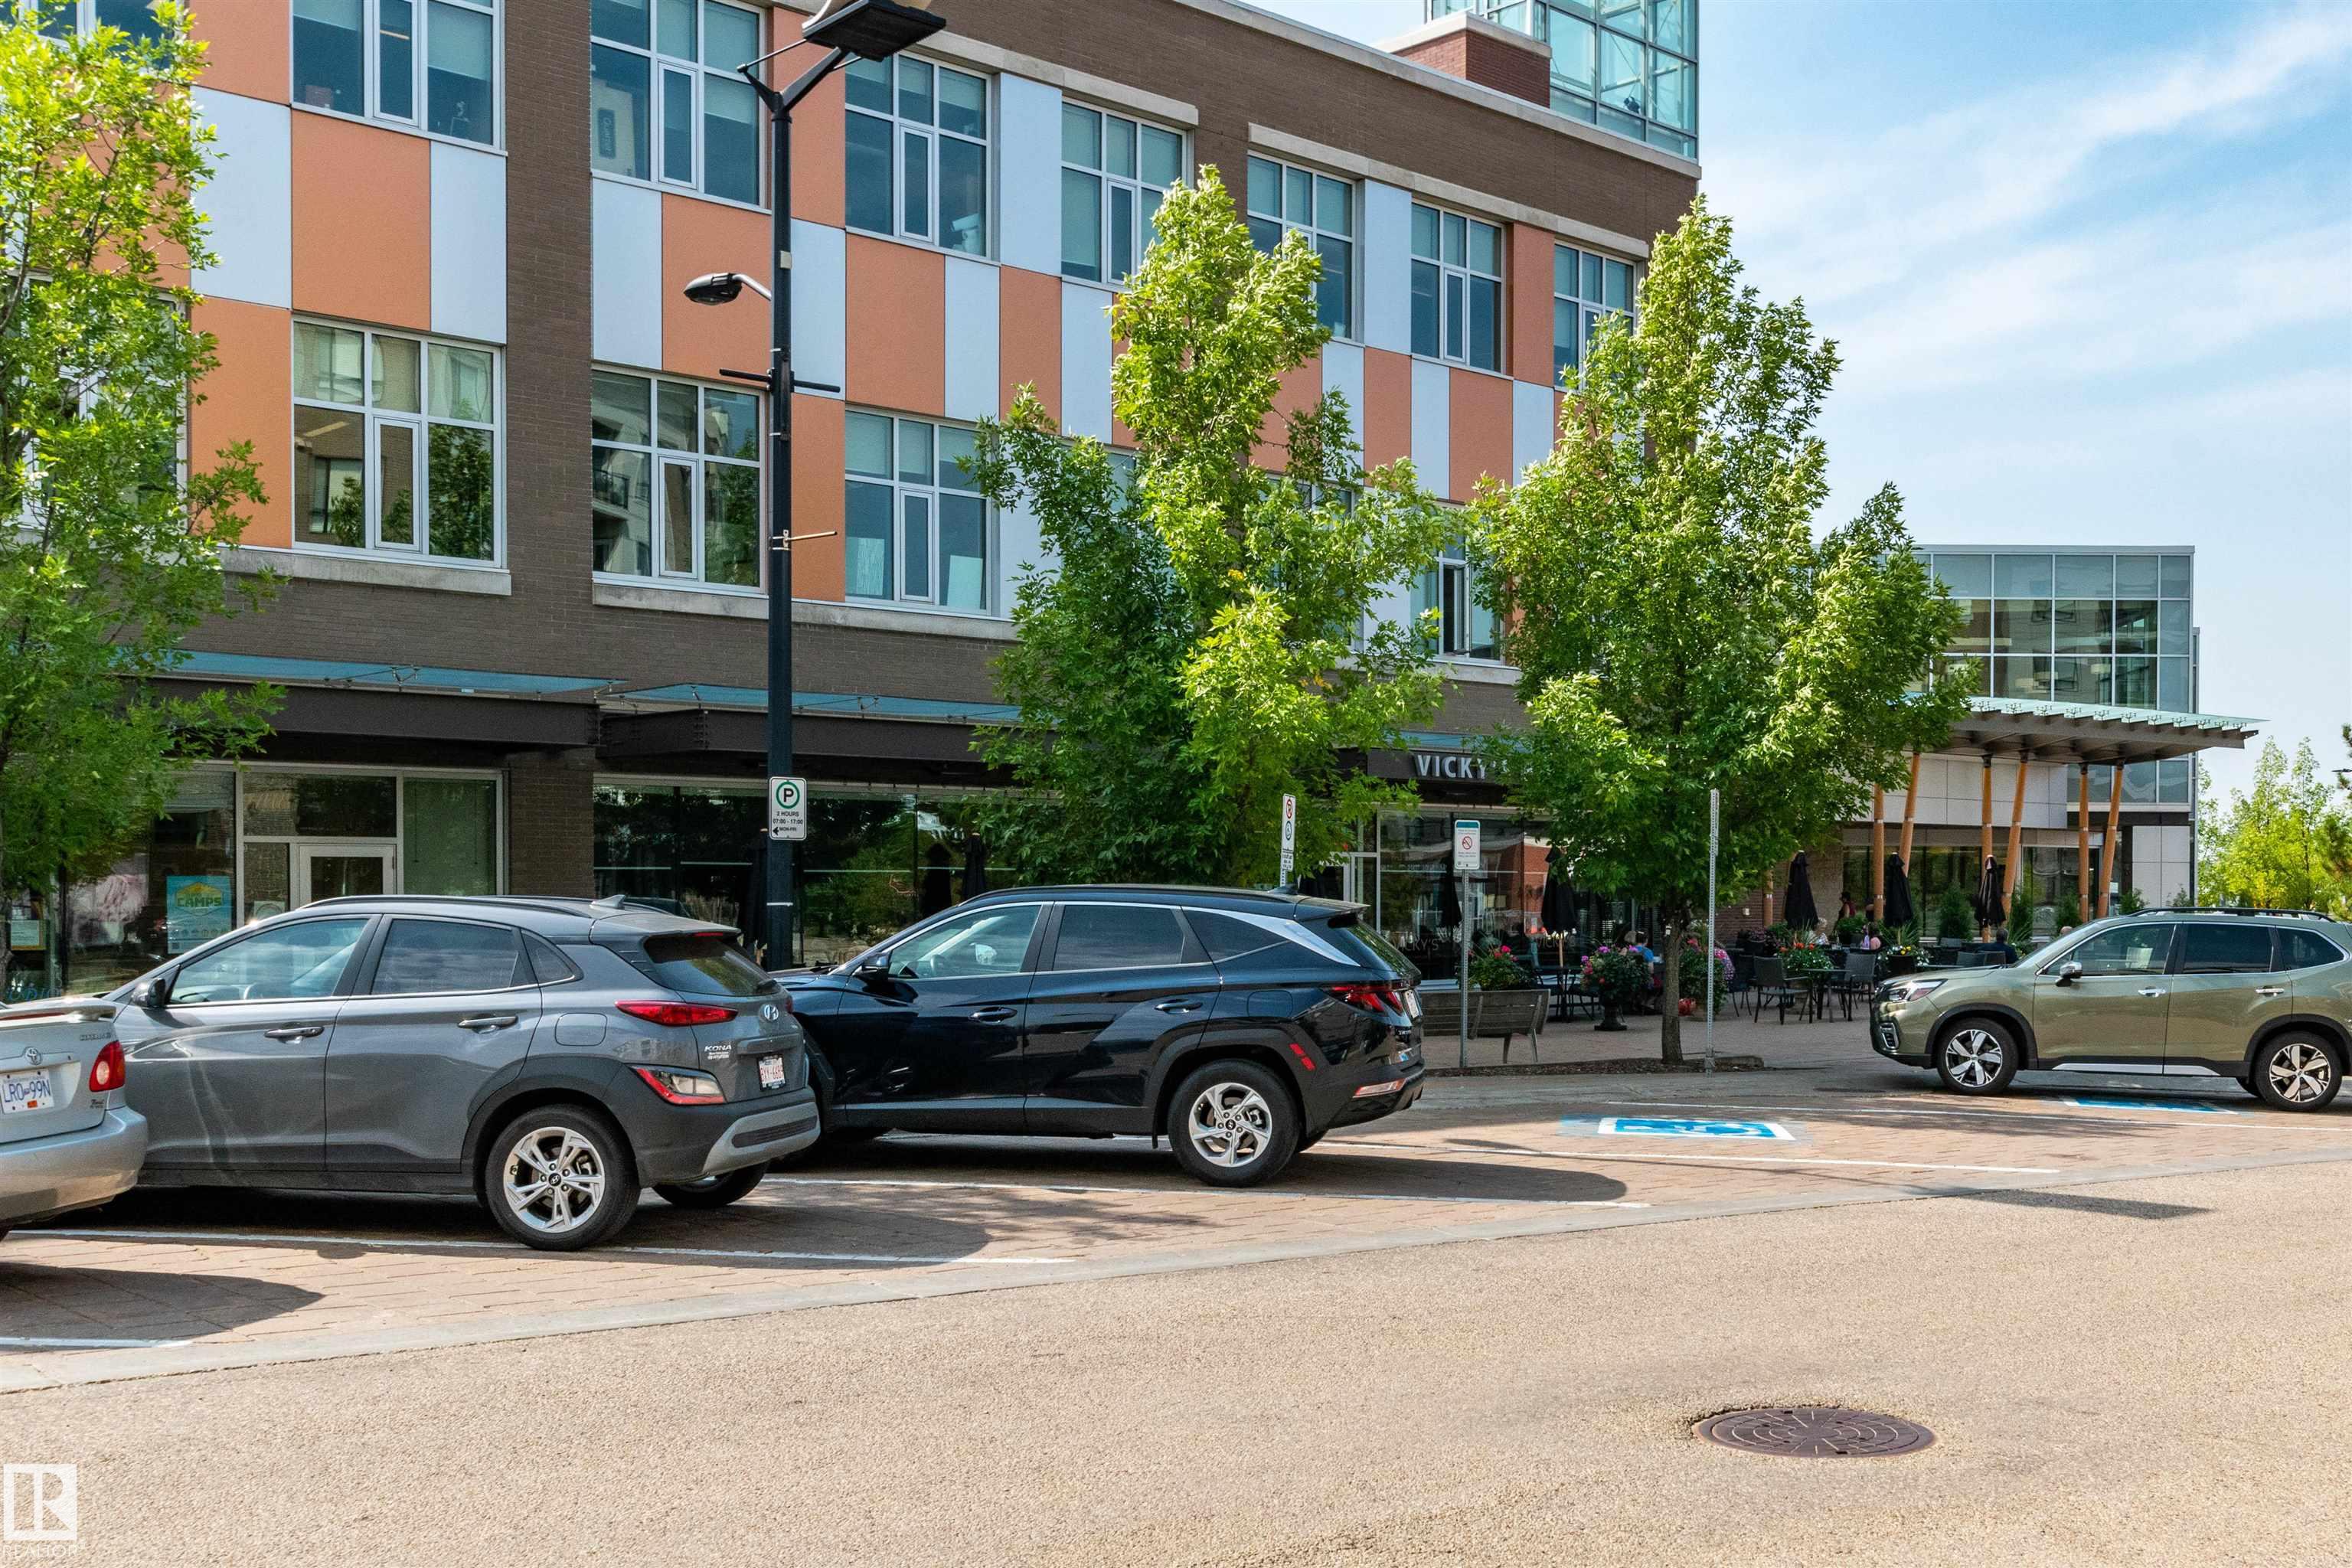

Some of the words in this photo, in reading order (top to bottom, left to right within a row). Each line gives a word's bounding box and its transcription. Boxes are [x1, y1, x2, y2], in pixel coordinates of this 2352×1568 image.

[783, 788, 794, 802] P
[177, 897, 221, 907] CAMPS
[29, 1079, 51, 1100] 99N
